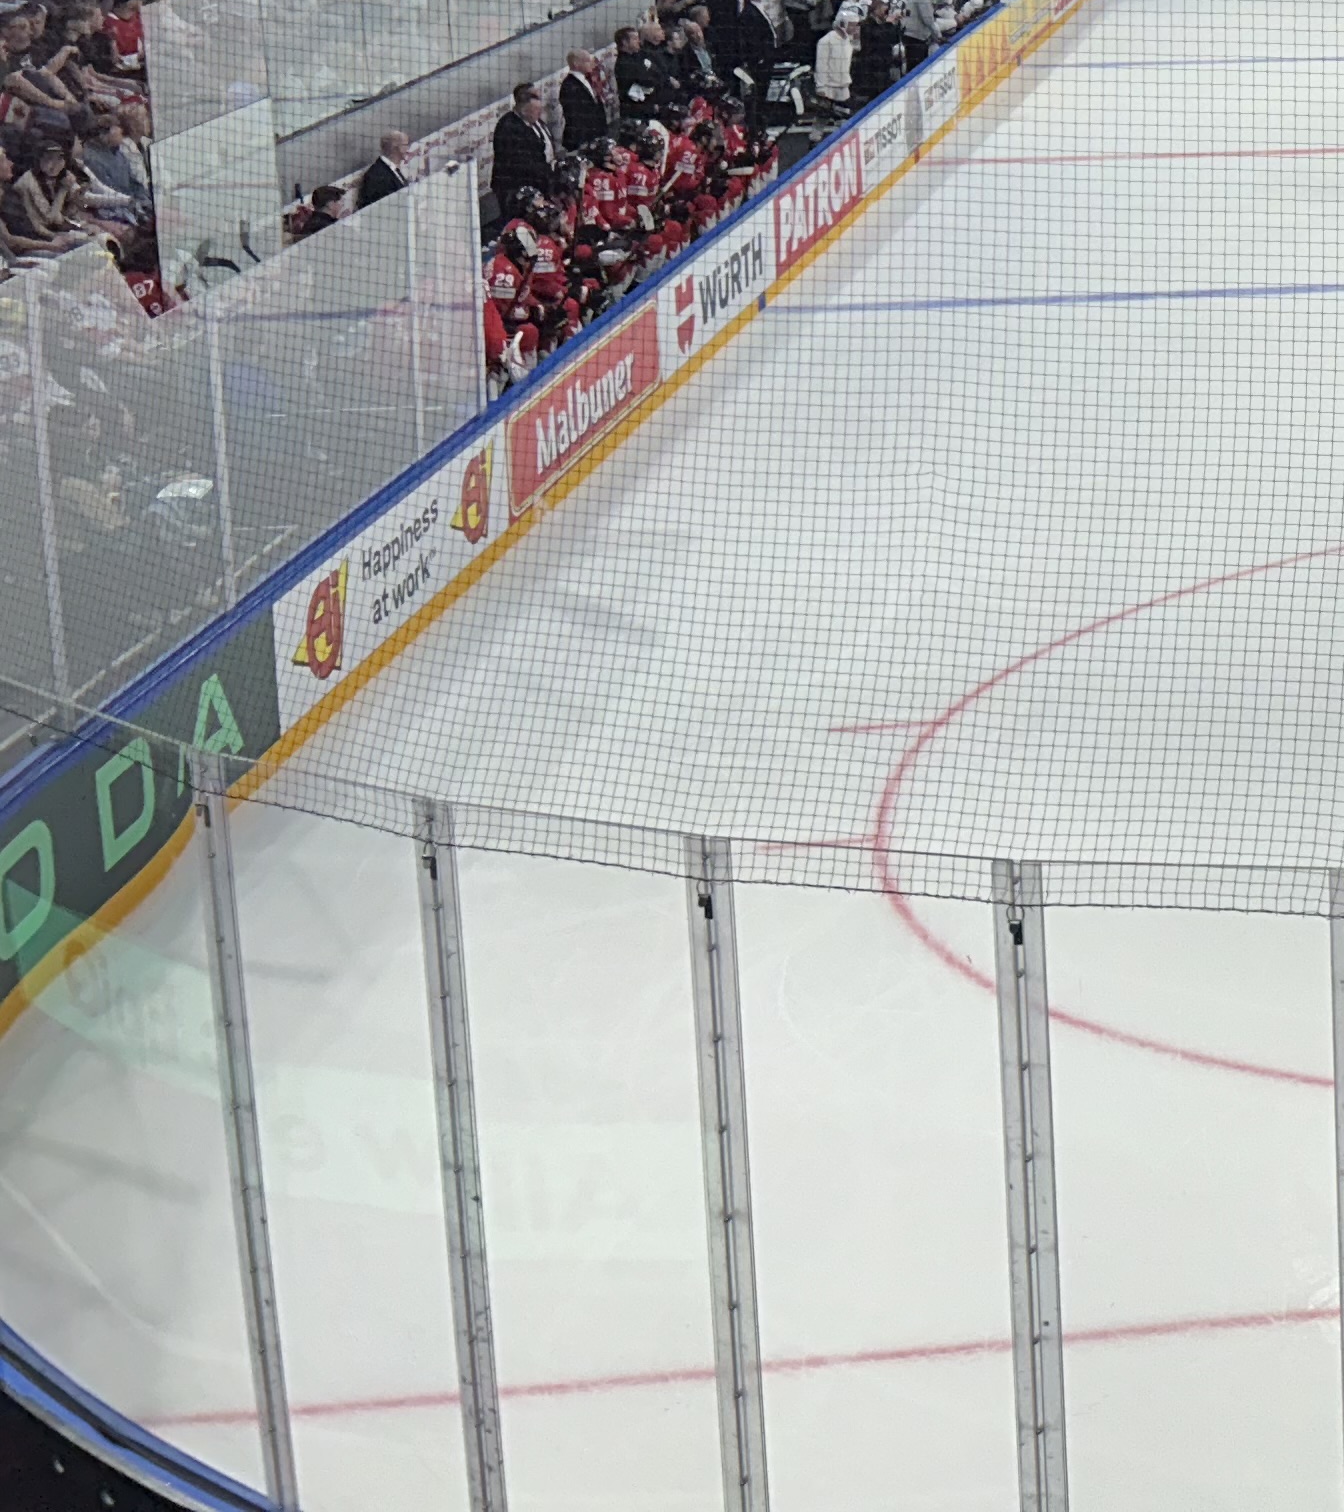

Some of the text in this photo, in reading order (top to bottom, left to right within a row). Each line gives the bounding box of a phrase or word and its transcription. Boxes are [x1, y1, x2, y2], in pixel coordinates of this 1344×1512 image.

[777, 137, 858, 265] PATRON
[534, 350, 635, 476] Malbuner
[361, 497, 440, 581] Happiness
[372, 589, 391, 625] at
